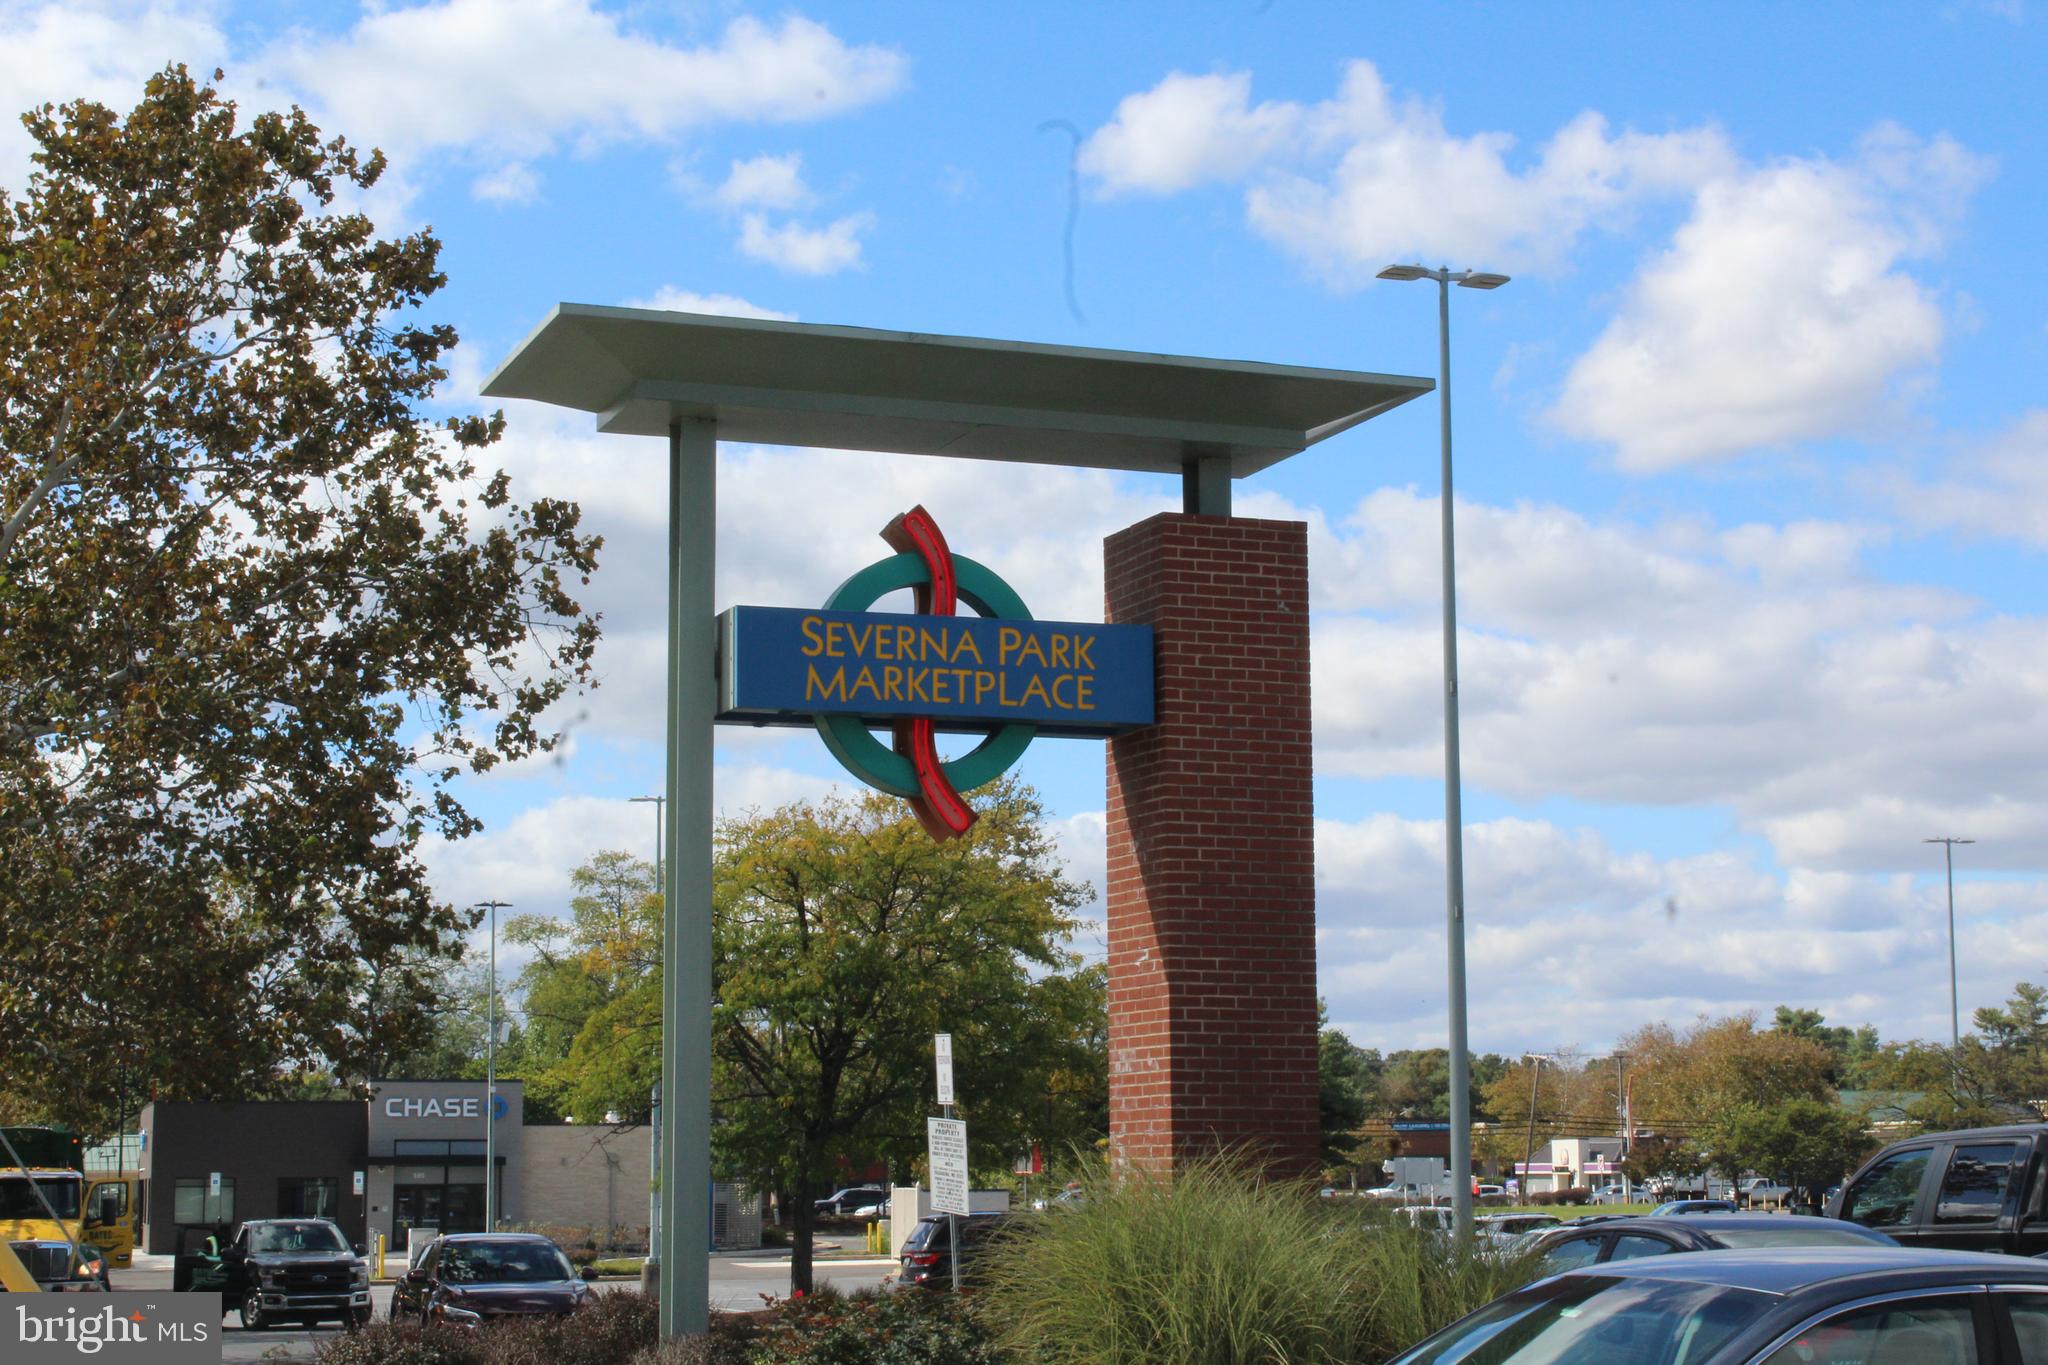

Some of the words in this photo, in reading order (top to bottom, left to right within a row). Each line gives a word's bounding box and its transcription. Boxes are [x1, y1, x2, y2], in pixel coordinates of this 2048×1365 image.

[801, 616, 983, 665] SEVERNA
[1000, 627, 1096, 670] PARK
[805, 663, 1096, 710] MARKETPLACE
[385, 1098, 480, 1117] CHASE
[934, 1129, 960, 1137] PROPERTY
[937, 1122, 957, 1130] PRIVATE
